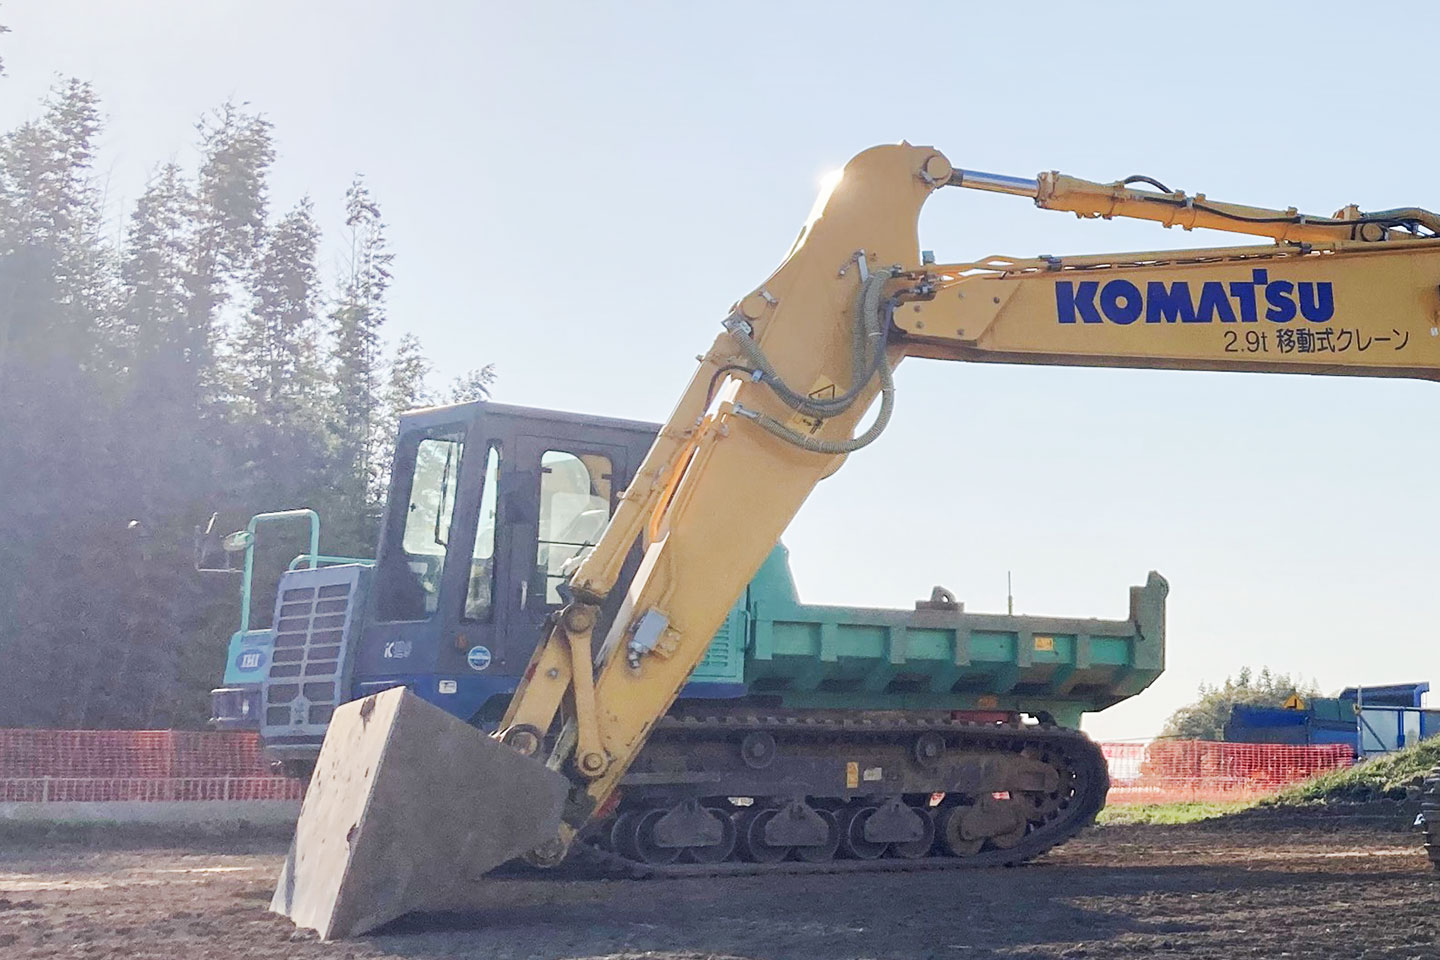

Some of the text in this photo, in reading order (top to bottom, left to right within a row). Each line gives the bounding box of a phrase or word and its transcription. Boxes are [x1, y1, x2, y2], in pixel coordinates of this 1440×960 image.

[1055, 269, 1335, 325] KOMATSU
[1223, 330, 1268, 353] 2.9t
[1276, 328, 1410, 354] 移動式クレーン
